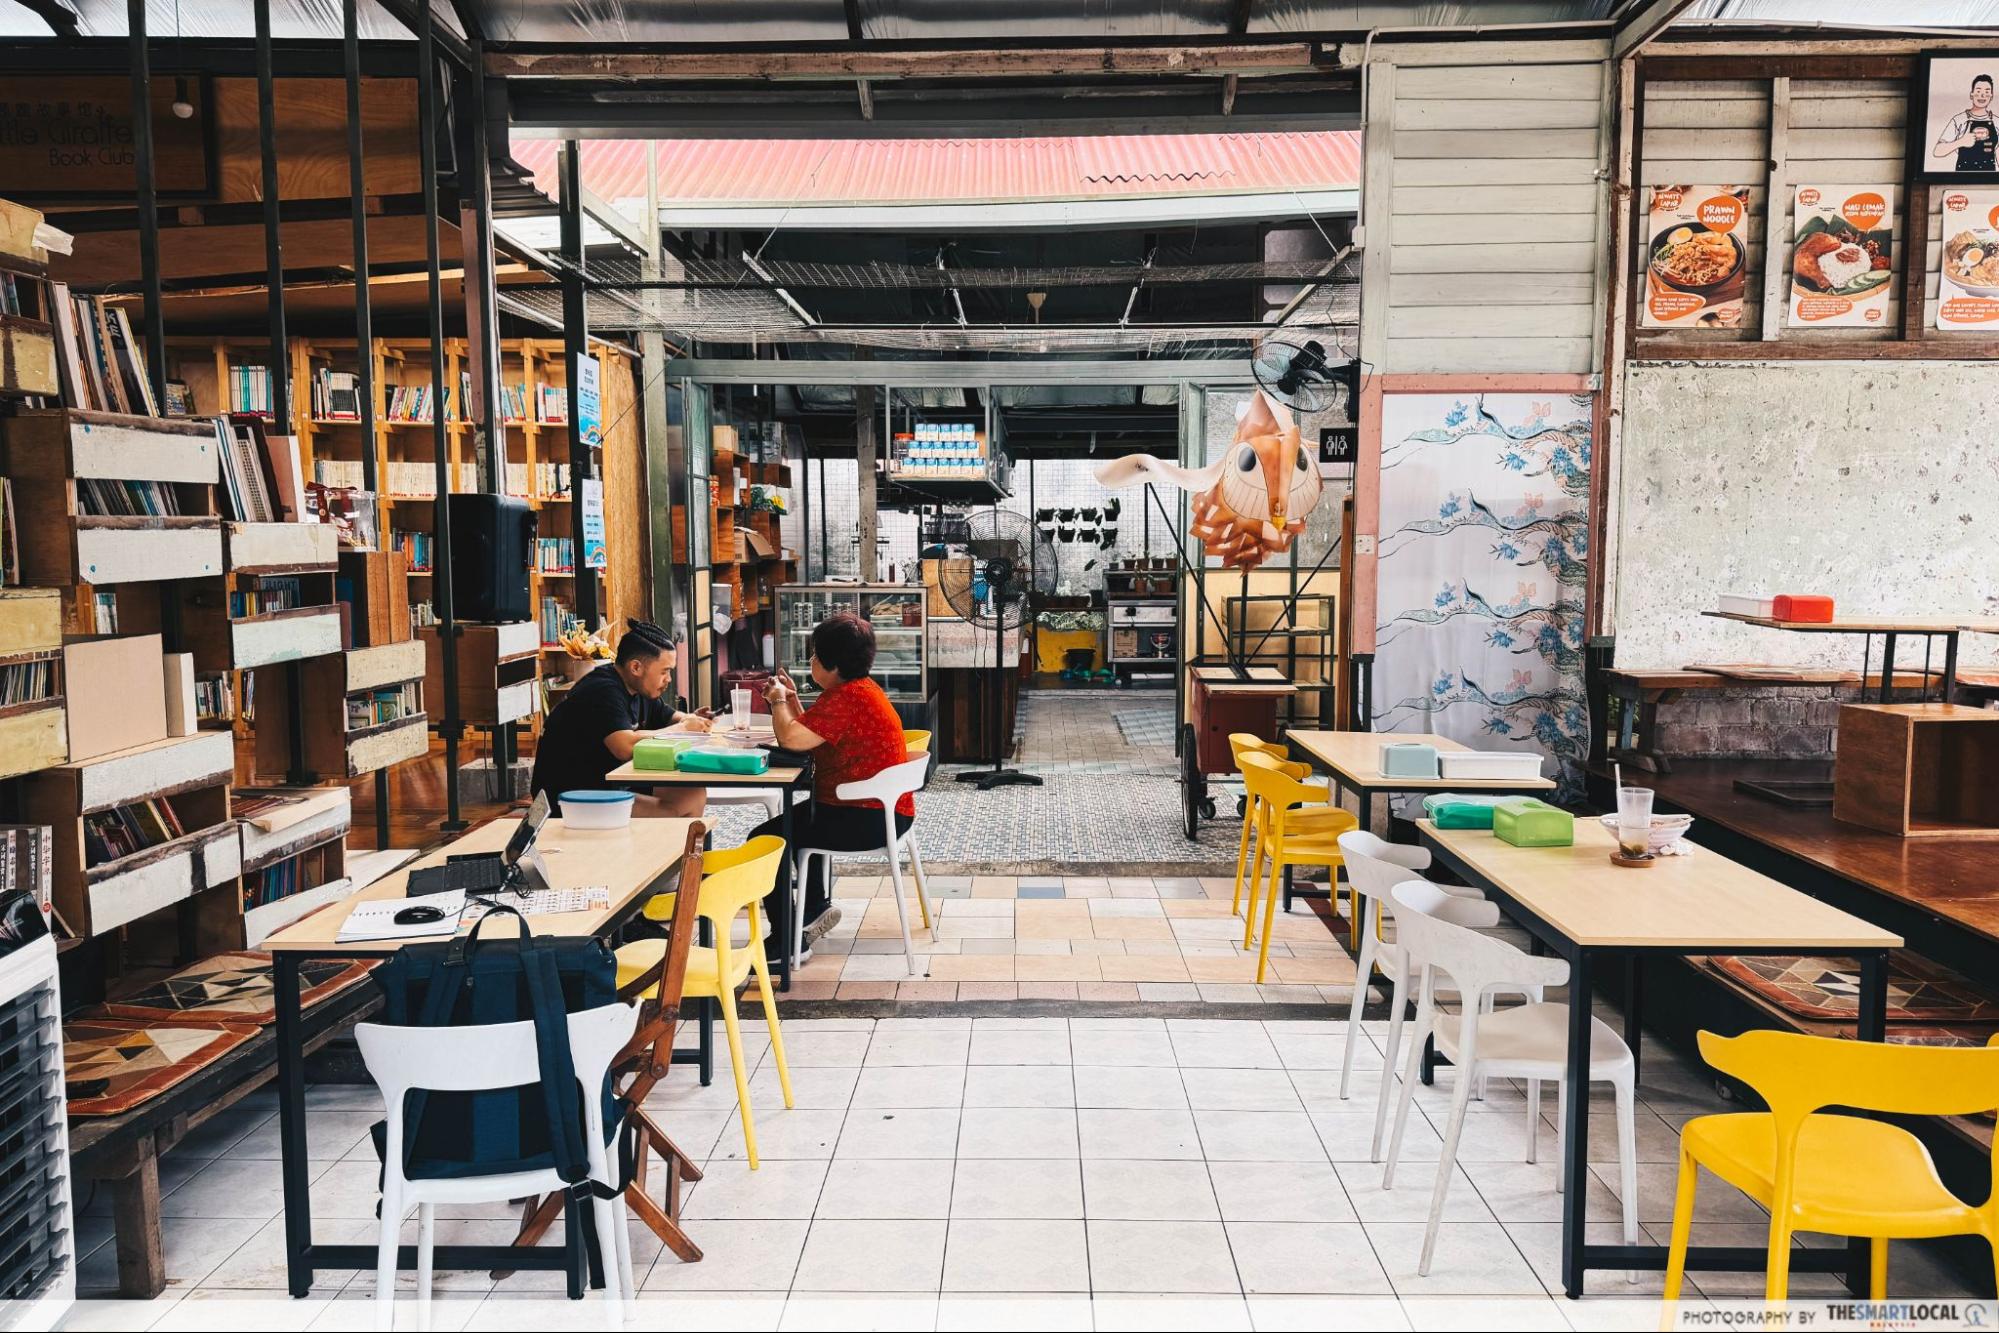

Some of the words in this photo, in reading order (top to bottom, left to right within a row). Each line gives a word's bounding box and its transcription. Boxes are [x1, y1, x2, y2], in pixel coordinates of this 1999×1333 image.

[49, 147, 92, 166] Book
[98, 146, 136, 166] Club
[1703, 204, 1735, 214] PRAWN
[1862, 202, 1885, 211] LEMAK
[1703, 214, 1735, 223] NOODLE
